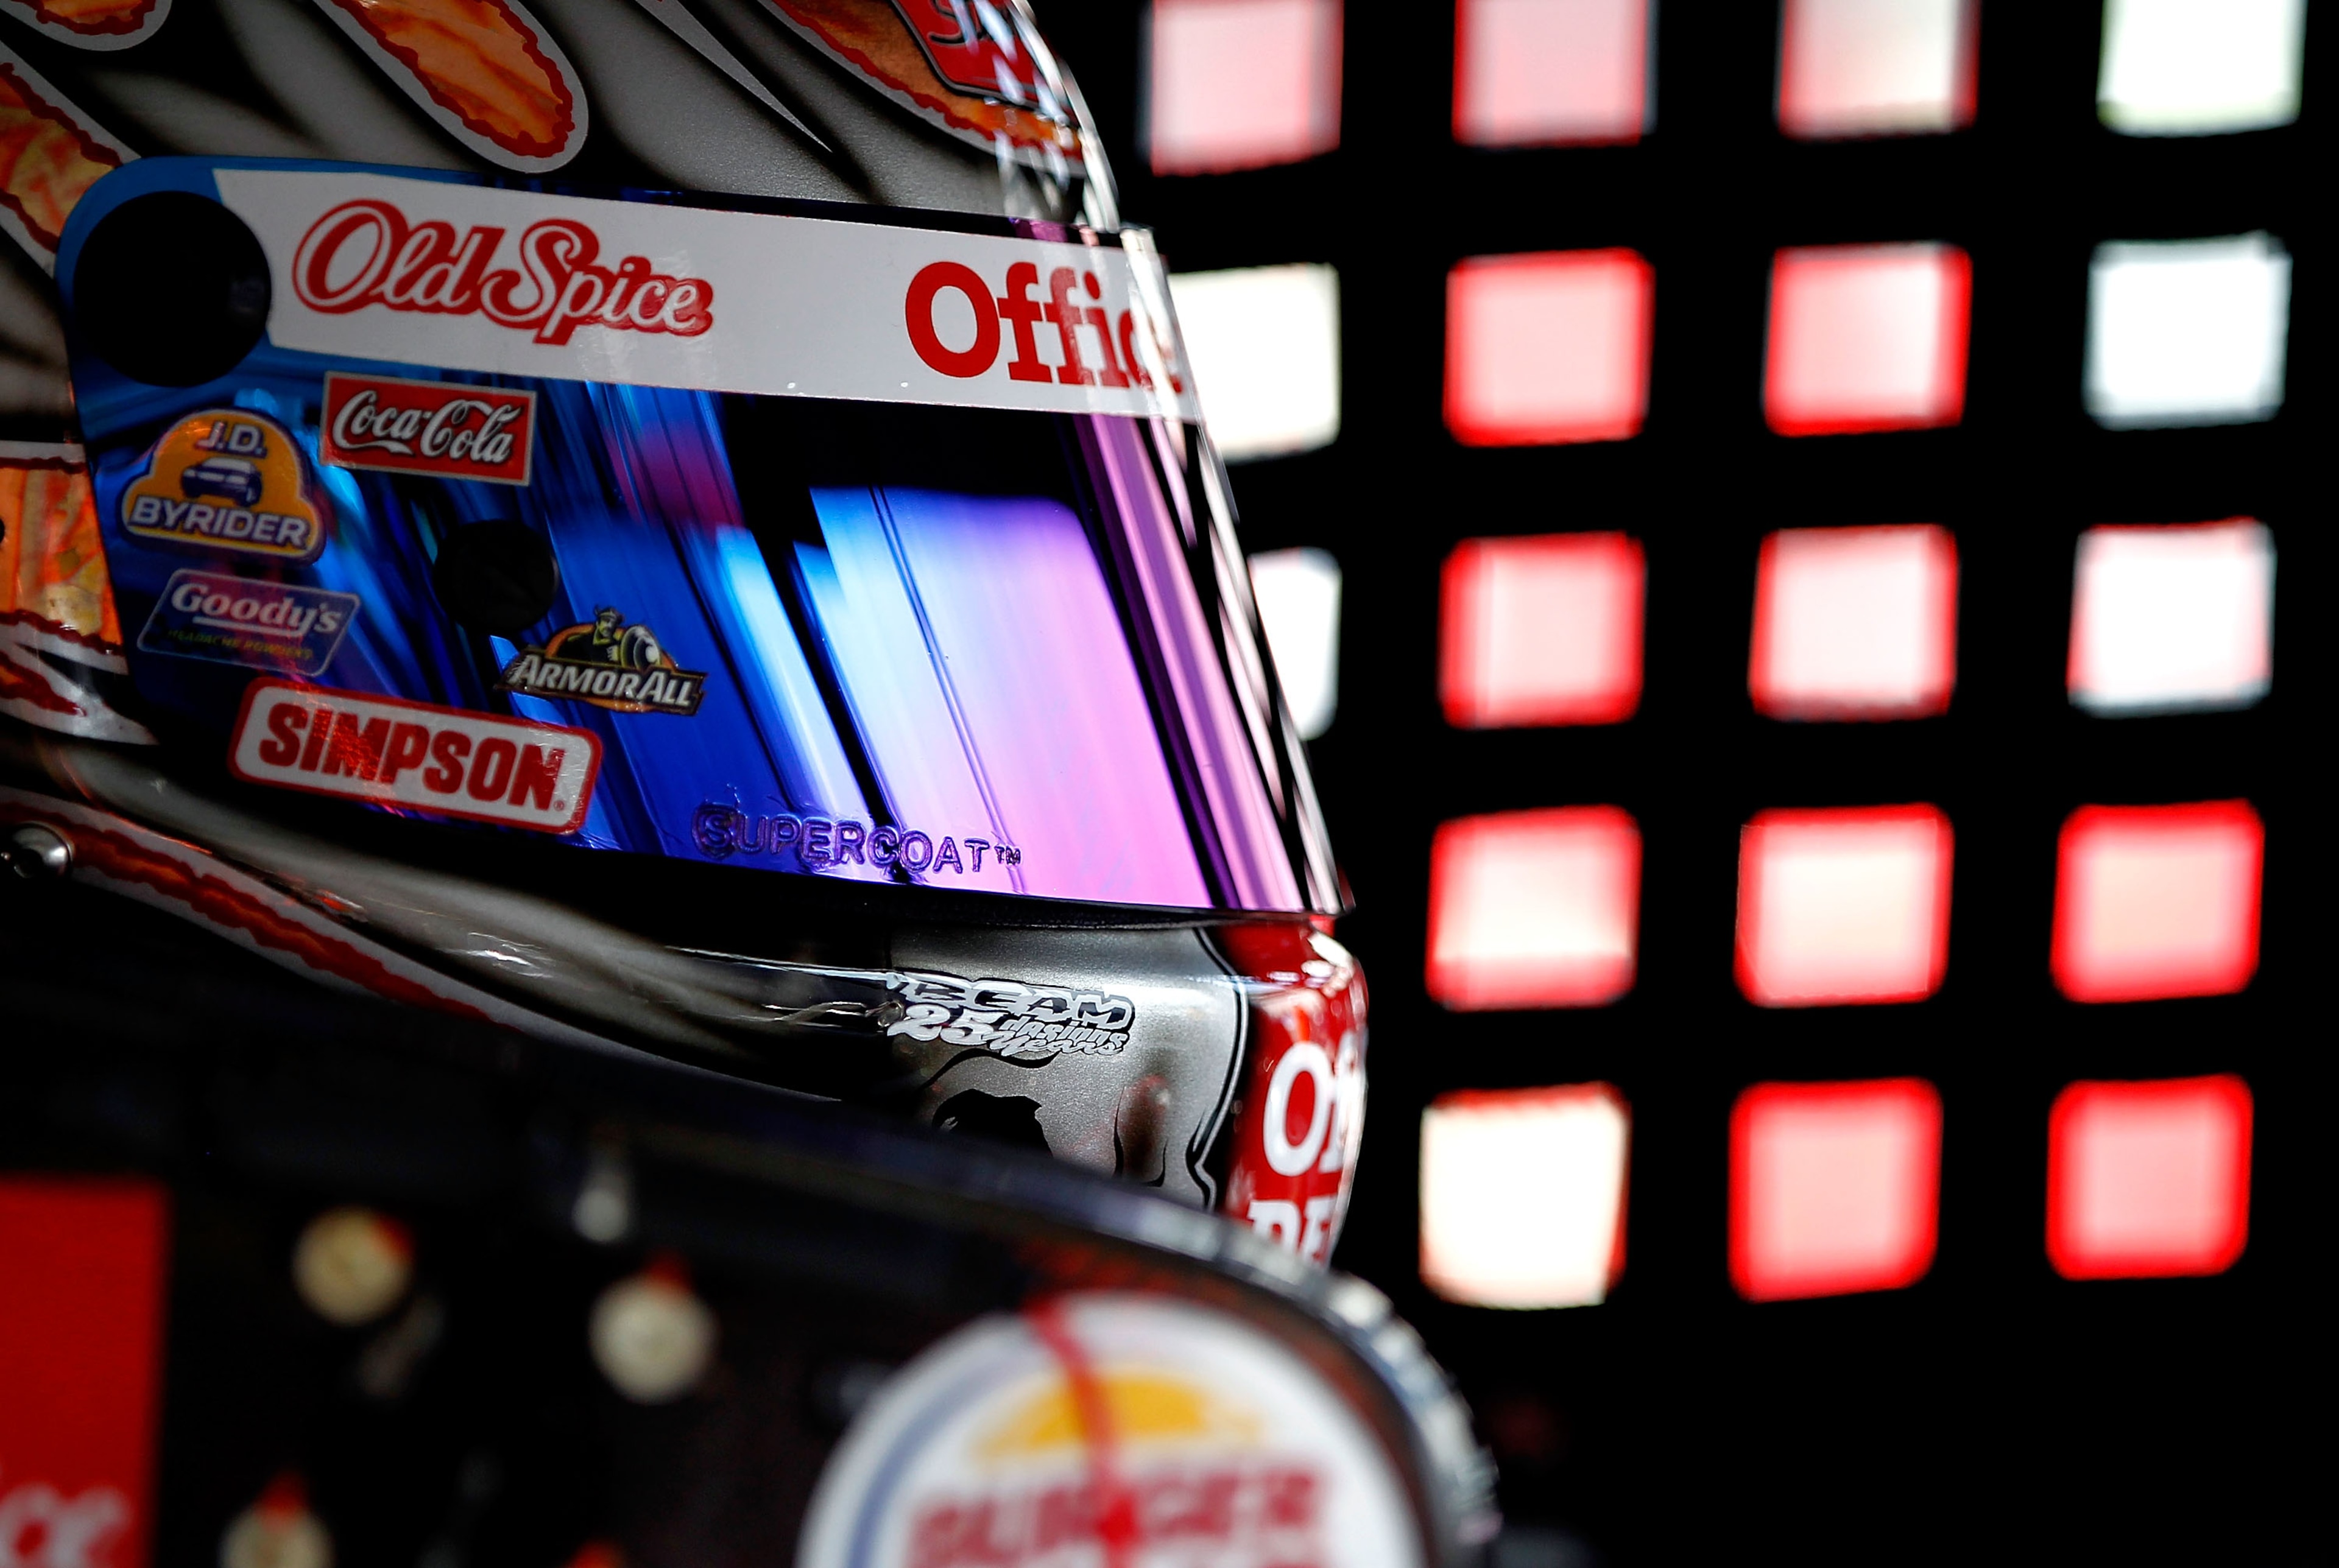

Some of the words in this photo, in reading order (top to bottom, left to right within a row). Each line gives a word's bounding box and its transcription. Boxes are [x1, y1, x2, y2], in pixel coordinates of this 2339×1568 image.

[292, 199, 505, 315] Old
[481, 218, 714, 346] Spice
[195, 420, 267, 458] J.D.
[332, 389, 522, 463] Coca-Cola
[129, 495, 311, 547] BYRIDER
[171, 582, 341, 638] Goody's
[887, 1004, 1009, 1046] 25
